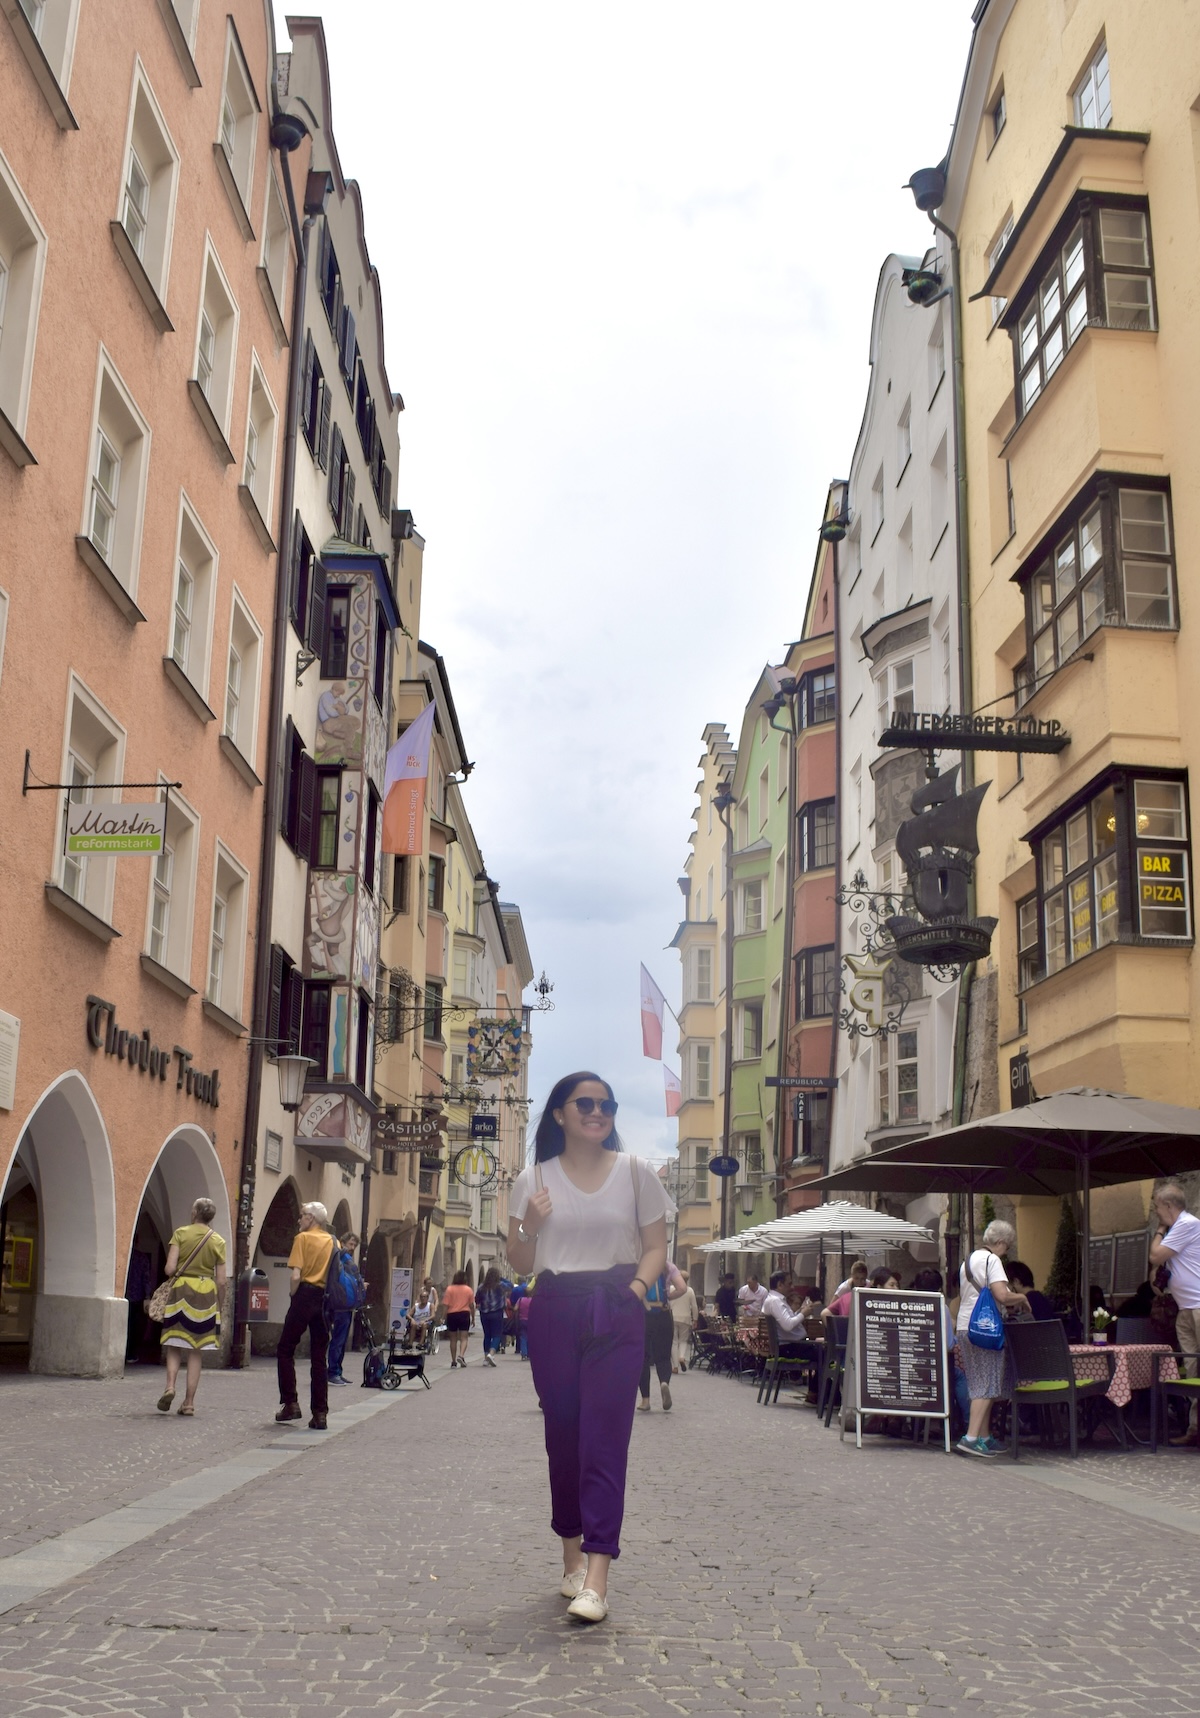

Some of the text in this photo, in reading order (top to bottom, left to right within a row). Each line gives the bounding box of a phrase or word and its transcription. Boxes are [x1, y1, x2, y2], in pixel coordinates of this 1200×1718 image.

[891, 711, 1004, 735] UNTERBERGER
[70, 809, 162, 836] Martin
[407, 789, 419, 851] Innsbruck singt
[76, 838, 153, 849] reformstark
[1143, 856, 1171, 872] BAR
[1143, 885, 1184, 902] PIZZA
[86, 994, 171, 1081] Theodor
[306, 1098, 334, 1127] 1925
[377, 1119, 439, 1135] GASTHOF
[474, 1122, 493, 1131] arko
[865, 1300, 899, 1310] Gemelli
[900, 1302, 934, 1312] Gemelli
